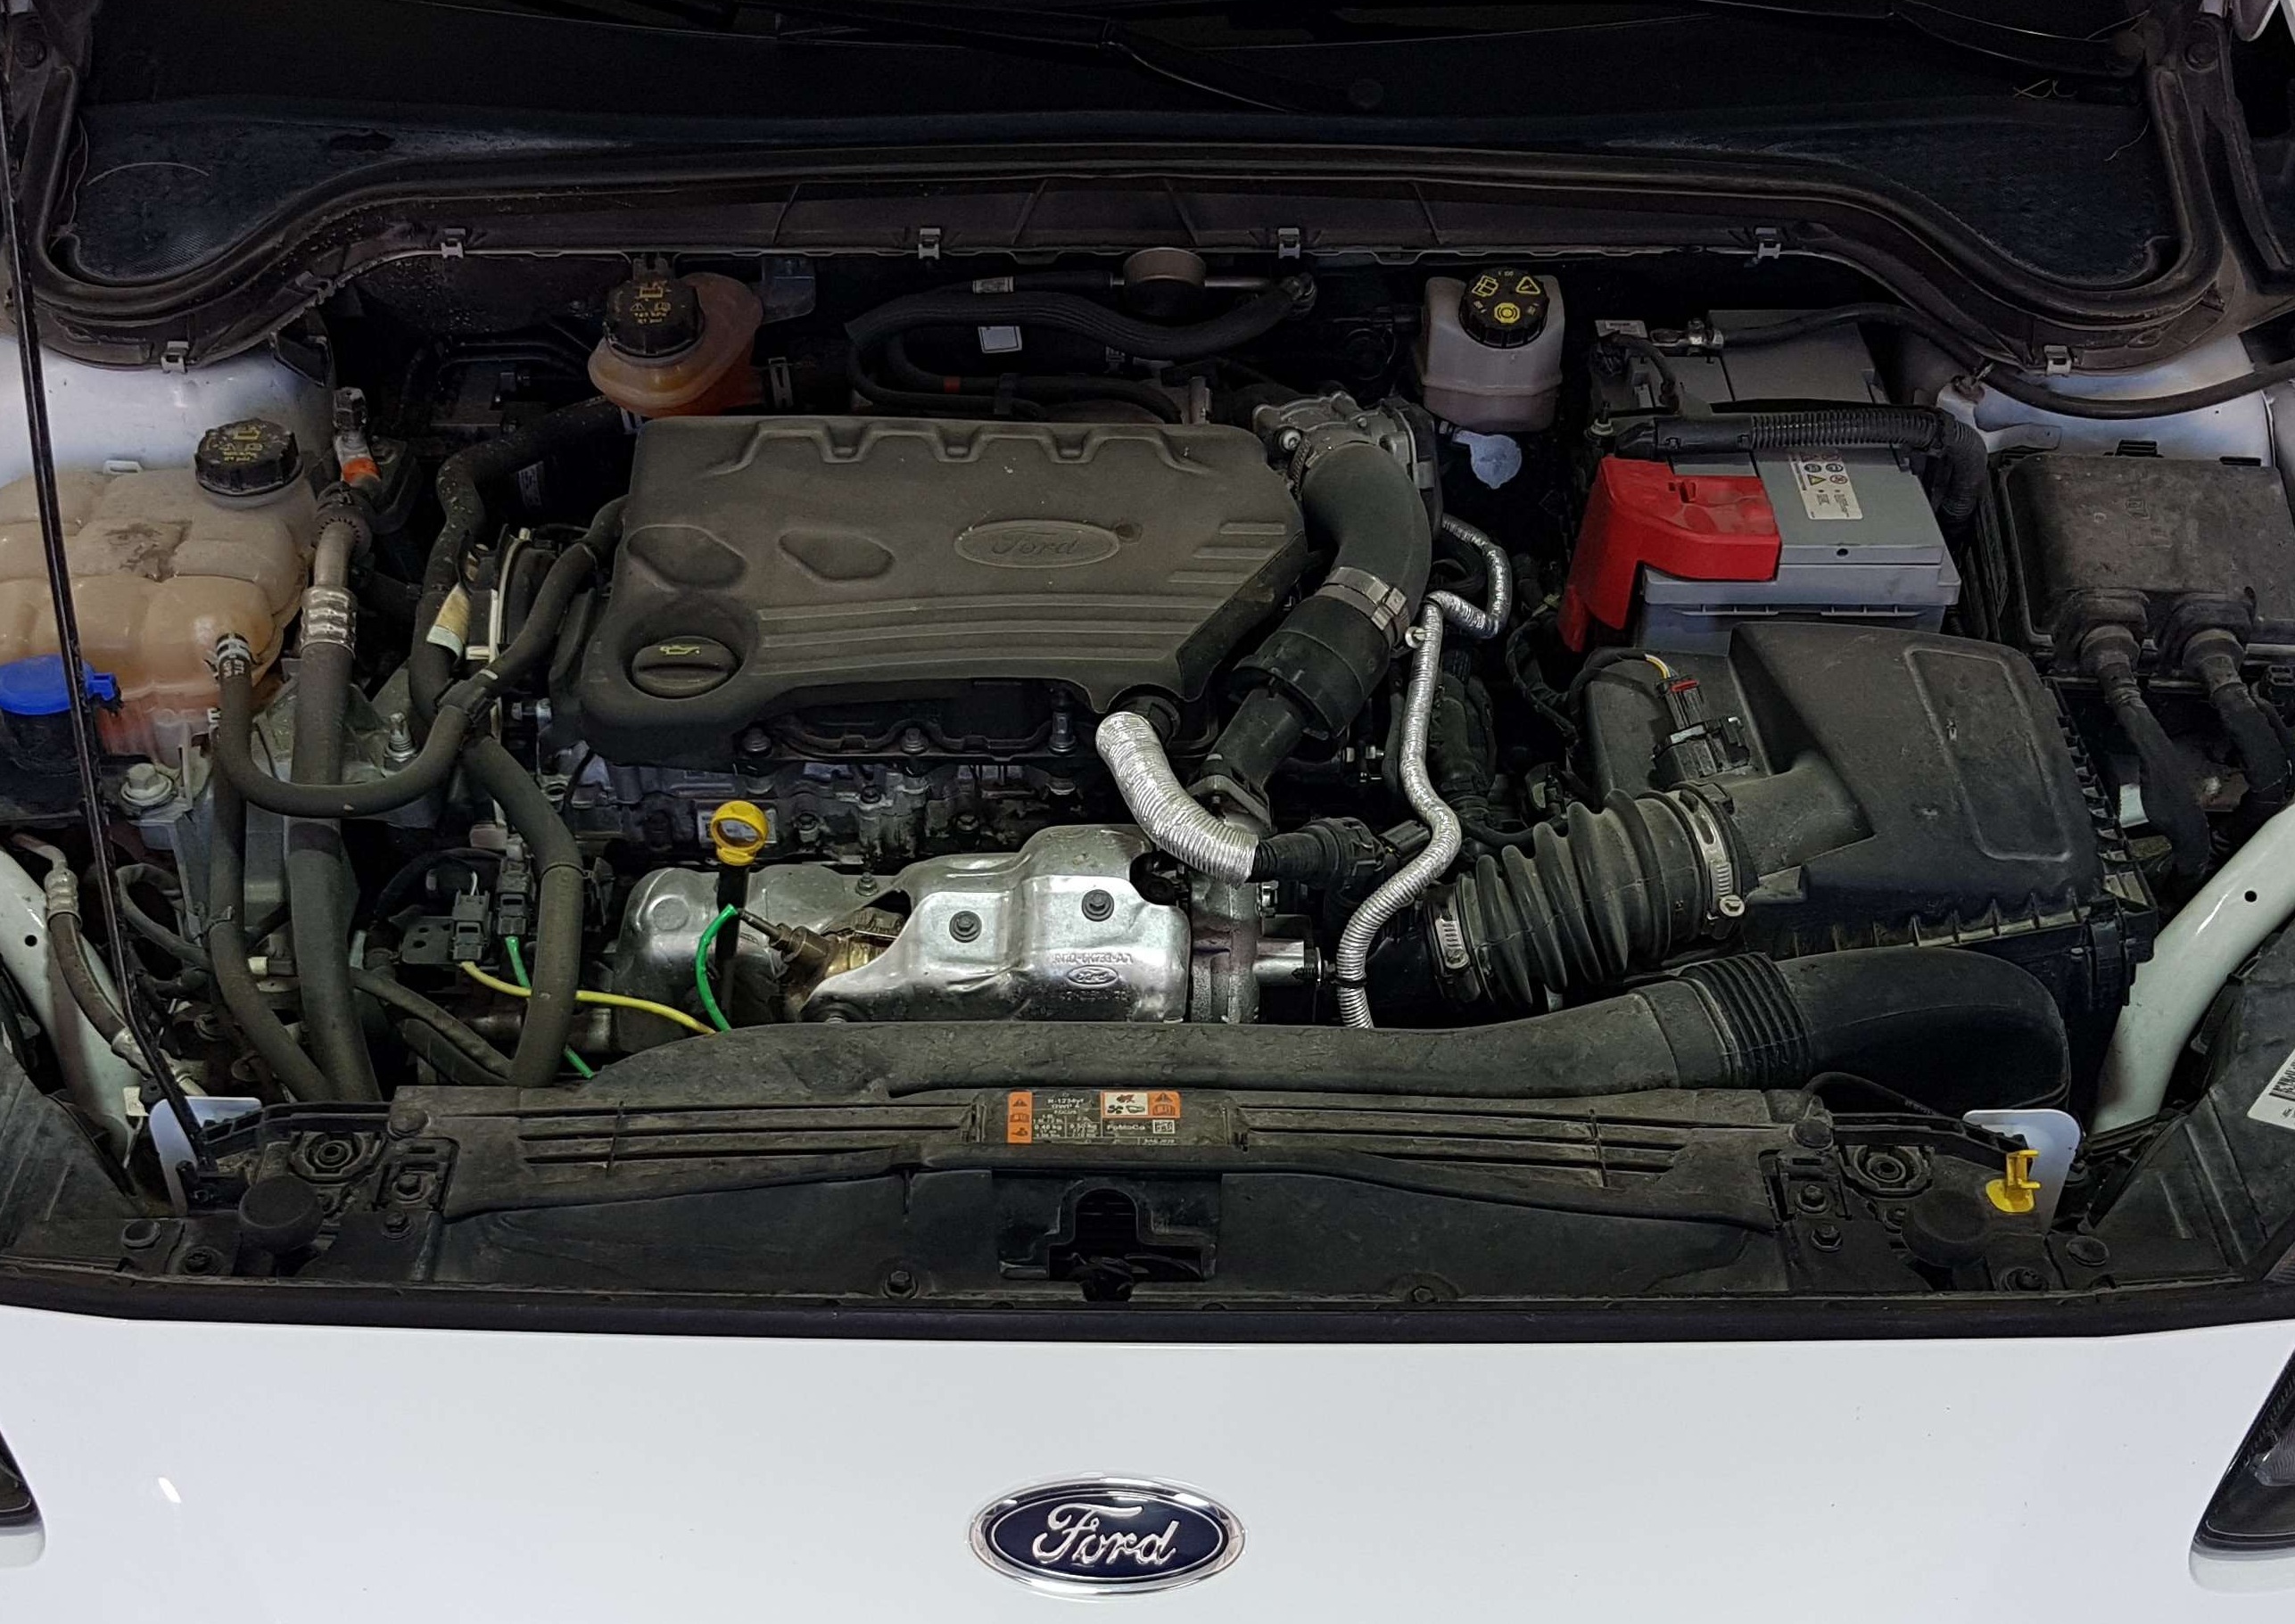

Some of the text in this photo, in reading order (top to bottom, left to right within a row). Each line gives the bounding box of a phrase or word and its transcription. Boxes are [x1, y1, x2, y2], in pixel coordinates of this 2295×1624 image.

[991, 530, 1079, 555] Ford
[1075, 969, 1110, 981] Ford
[1032, 1503, 1179, 1565] Ford
